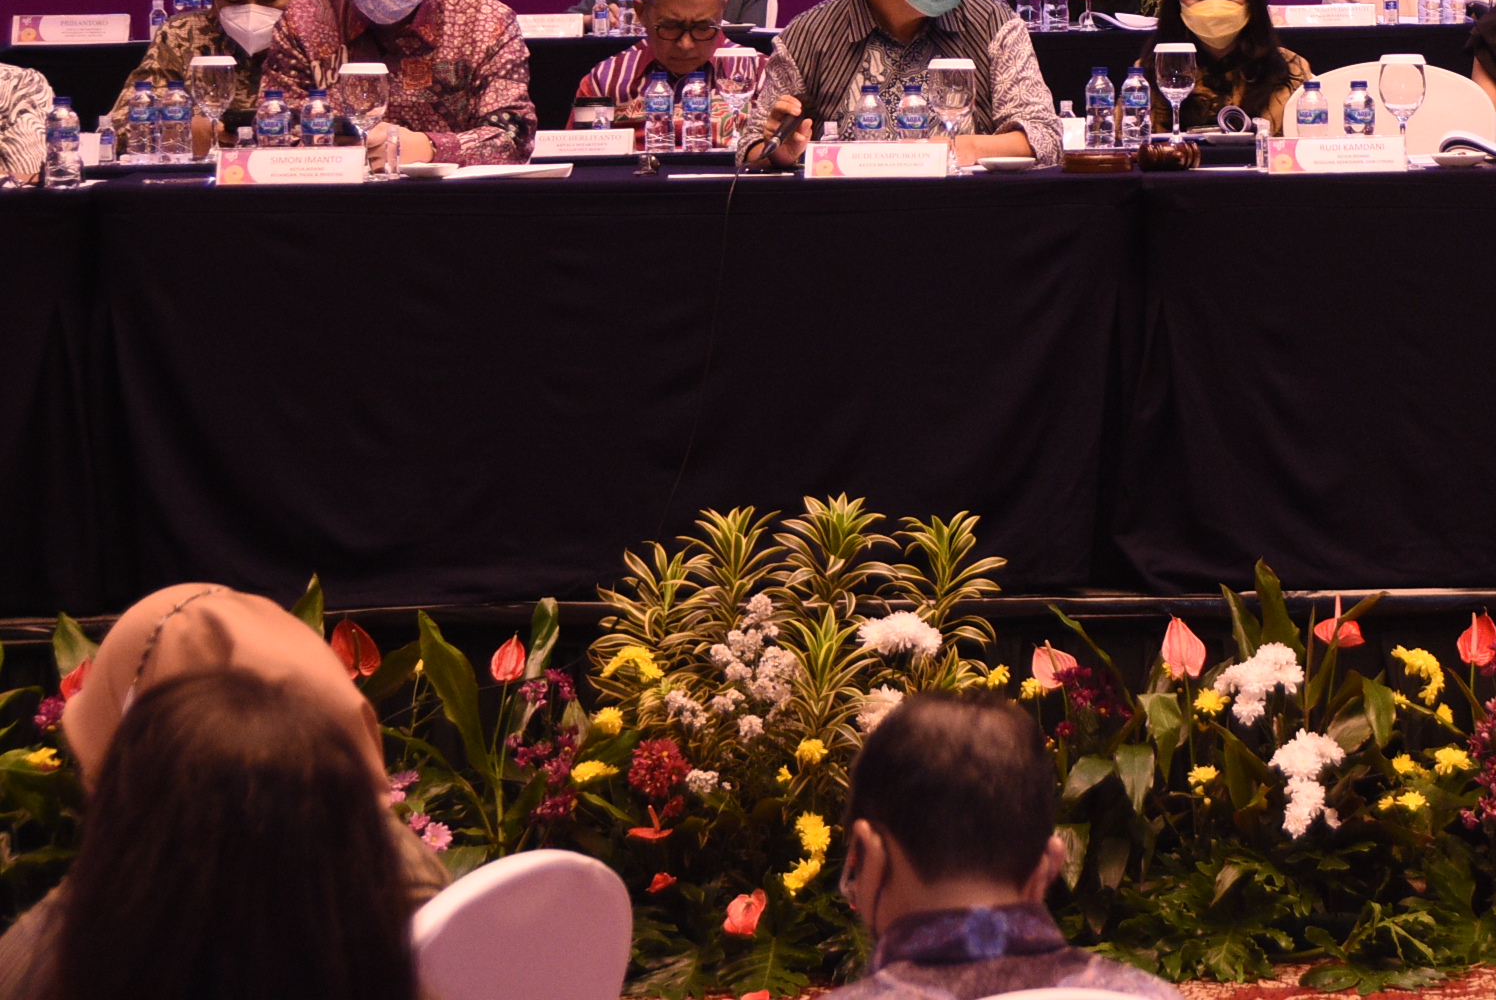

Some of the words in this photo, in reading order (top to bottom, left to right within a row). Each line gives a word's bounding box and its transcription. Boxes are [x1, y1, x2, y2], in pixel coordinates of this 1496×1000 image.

[1319, 143, 1341, 152] RUDI
[1343, 143, 1385, 151] KAMDANI
[270, 156, 302, 165] SIMON
[304, 155, 343, 164] IMANTO
[874, 152, 930, 160] TAMPUBOLON
